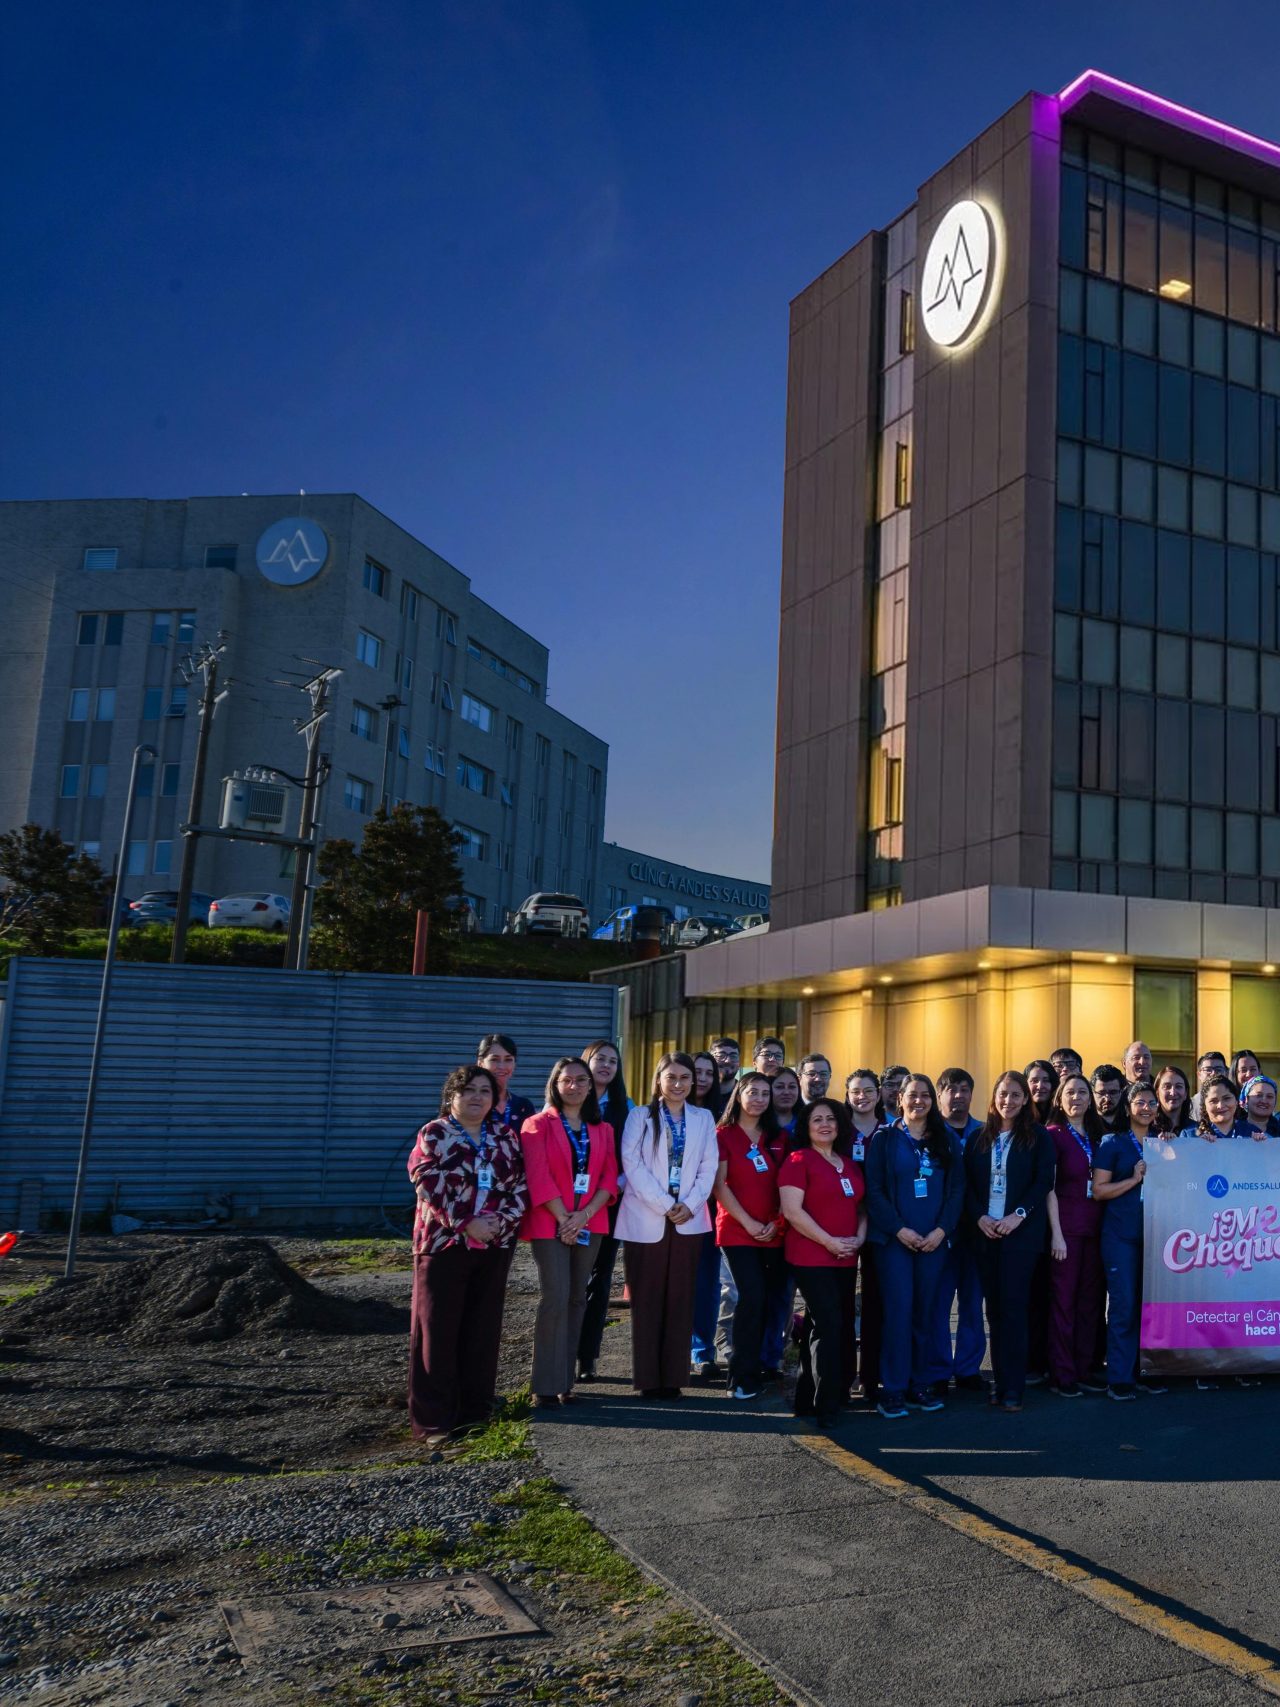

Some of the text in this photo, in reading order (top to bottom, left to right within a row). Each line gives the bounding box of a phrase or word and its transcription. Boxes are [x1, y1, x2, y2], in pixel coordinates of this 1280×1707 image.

[629, 861, 769, 910] CLÍNICA ANDES SALUD
[1186, 1182, 1198, 1191] EN
[1232, 1182, 1259, 1191] ANDES
[1186, 1310, 1239, 1323] Detectar
[1243, 1310, 1254, 1322] el
[1245, 1323, 1276, 1336] hace
